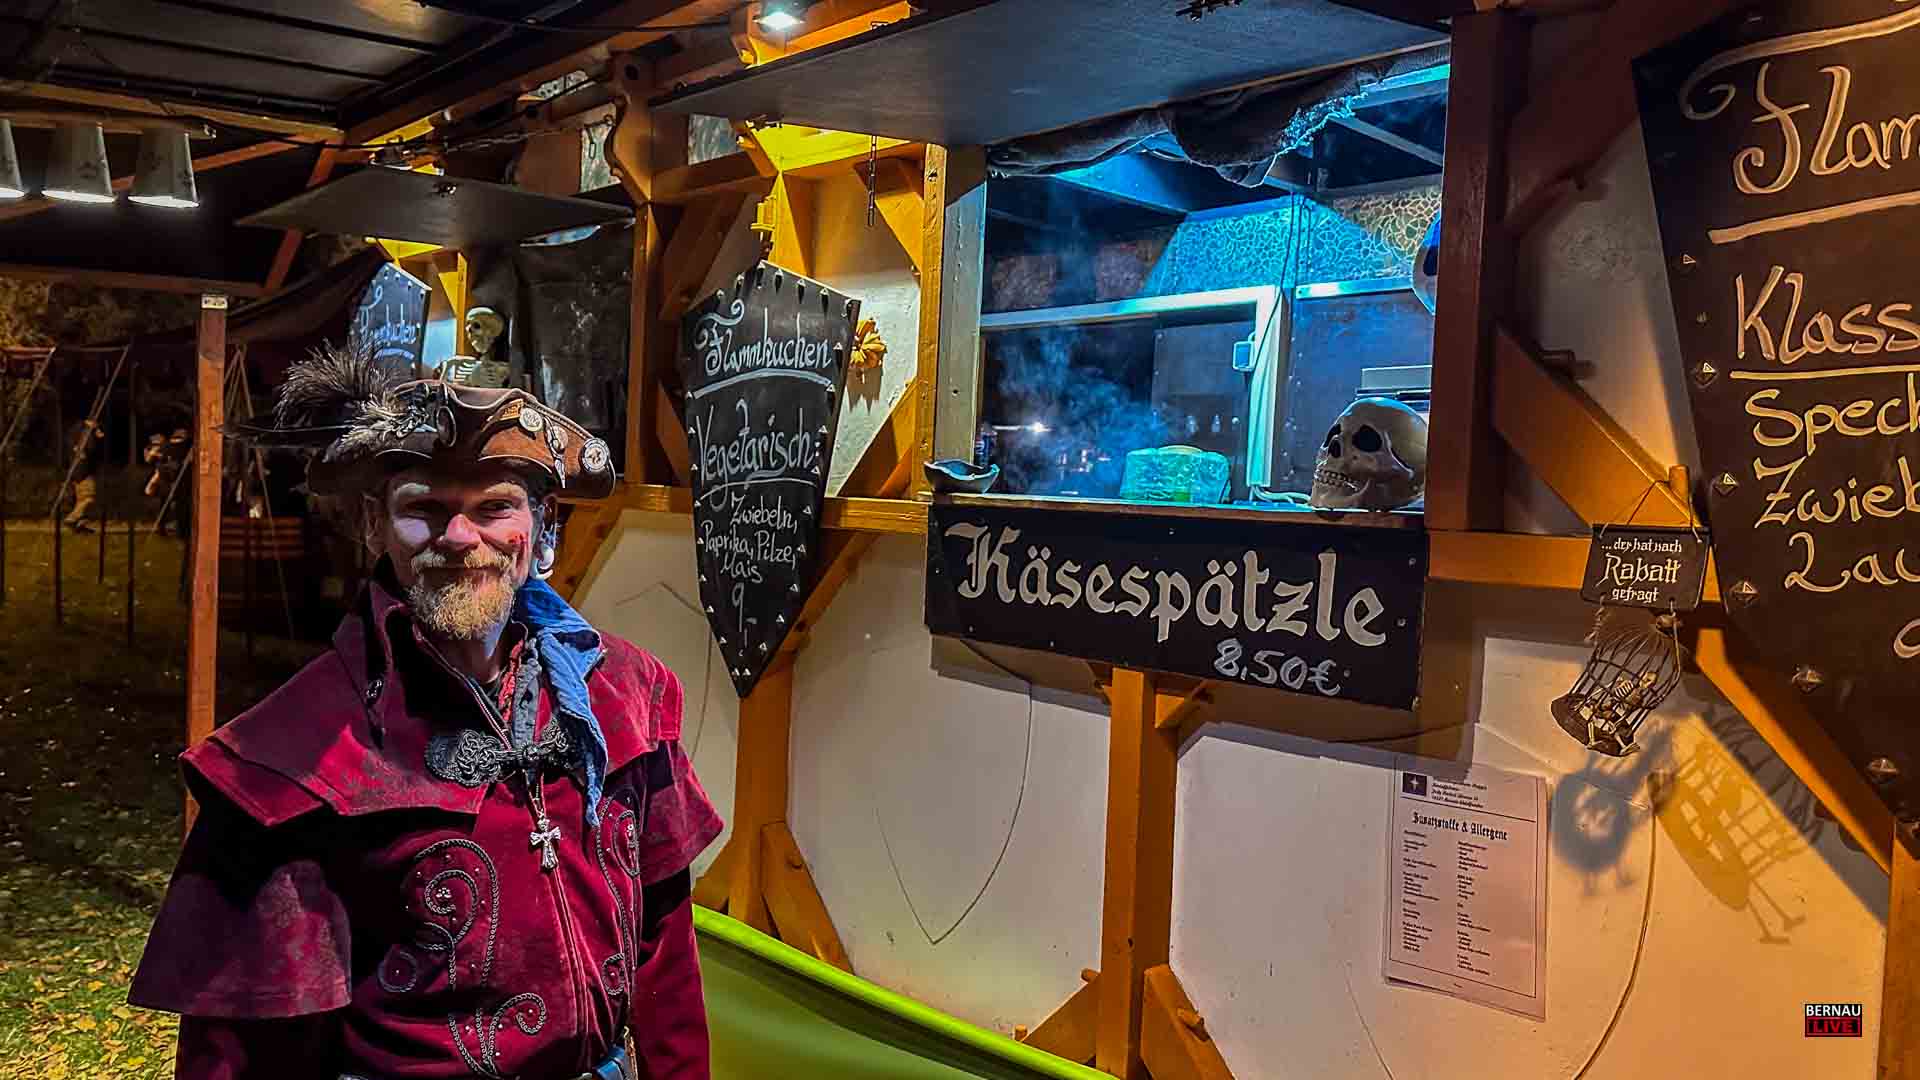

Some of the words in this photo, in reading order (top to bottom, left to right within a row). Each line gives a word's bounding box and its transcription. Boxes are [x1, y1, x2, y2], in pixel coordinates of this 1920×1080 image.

[1735, 265, 1920, 364] Klass
[705, 306, 832, 376] Flammkuchen
[730, 491, 797, 534] Zwiebeln,
[701, 519, 753, 559] Paprika,
[754, 530, 796, 570] Pilze,
[1630, 538, 1654, 553] hat
[1653, 539, 1682, 553] nach
[720, 552, 763, 583] Mais
[944, 522, 1386, 648] Käsespätzle
[1595, 552, 1681, 586] Rabatt
[1612, 587, 1659, 603] gefragt
[1213, 638, 1341, 696] 8,50€
[1412, 811, 1460, 832] Zusatzstoffe
[1461, 821, 1468, 833] &
[1471, 822, 1508, 840] Allergene
